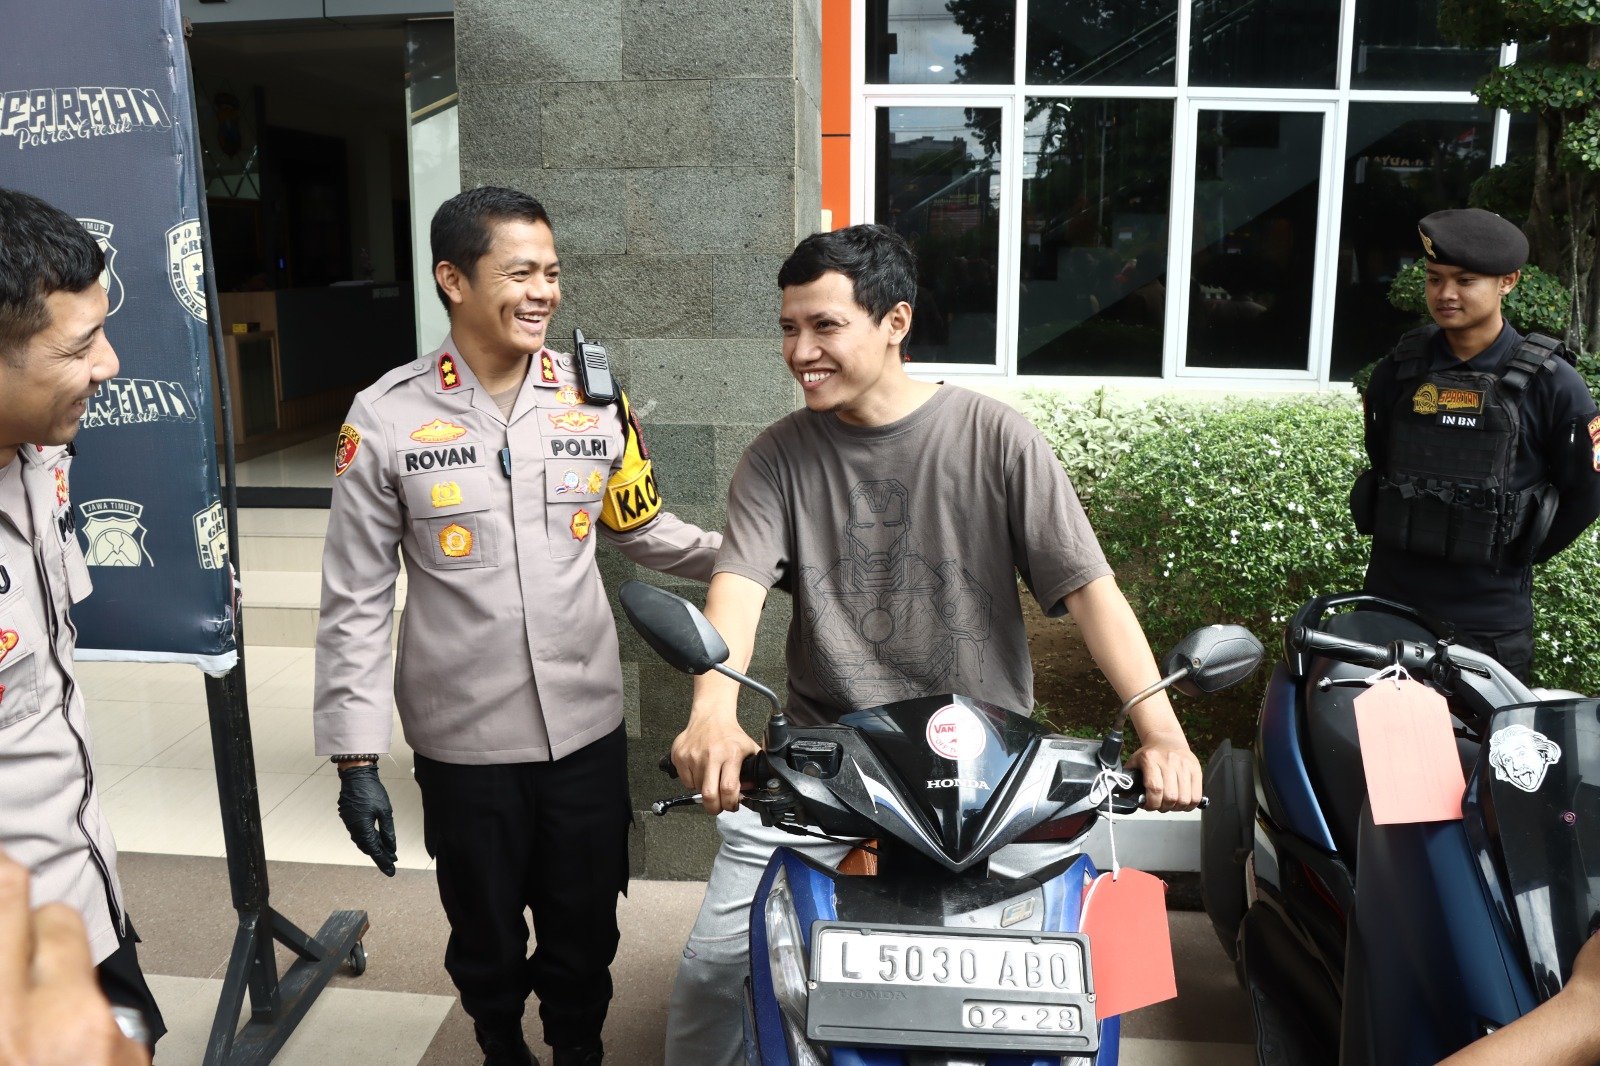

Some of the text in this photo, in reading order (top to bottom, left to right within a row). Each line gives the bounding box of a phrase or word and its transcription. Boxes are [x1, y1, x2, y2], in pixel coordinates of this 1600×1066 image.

[0, 87, 172, 136] PARTAN
[14, 116, 132, 150] Polres Gresik
[172, 262, 204, 316] RESERSE
[79, 378, 197, 423] RTAN
[107, 407, 159, 426] Gresik
[1442, 415, 1476, 427] IN BN
[550, 438, 607, 457] POLRI
[405, 446, 476, 472] ROVAN
[88, 502, 135, 512] JAWA TIMUR
[934, 723, 956, 733] VAN
[926, 778, 990, 790] HONDA
[841, 941, 1071, 990] L 5030 ABQ
[838, 988, 908, 1001] HONDA
